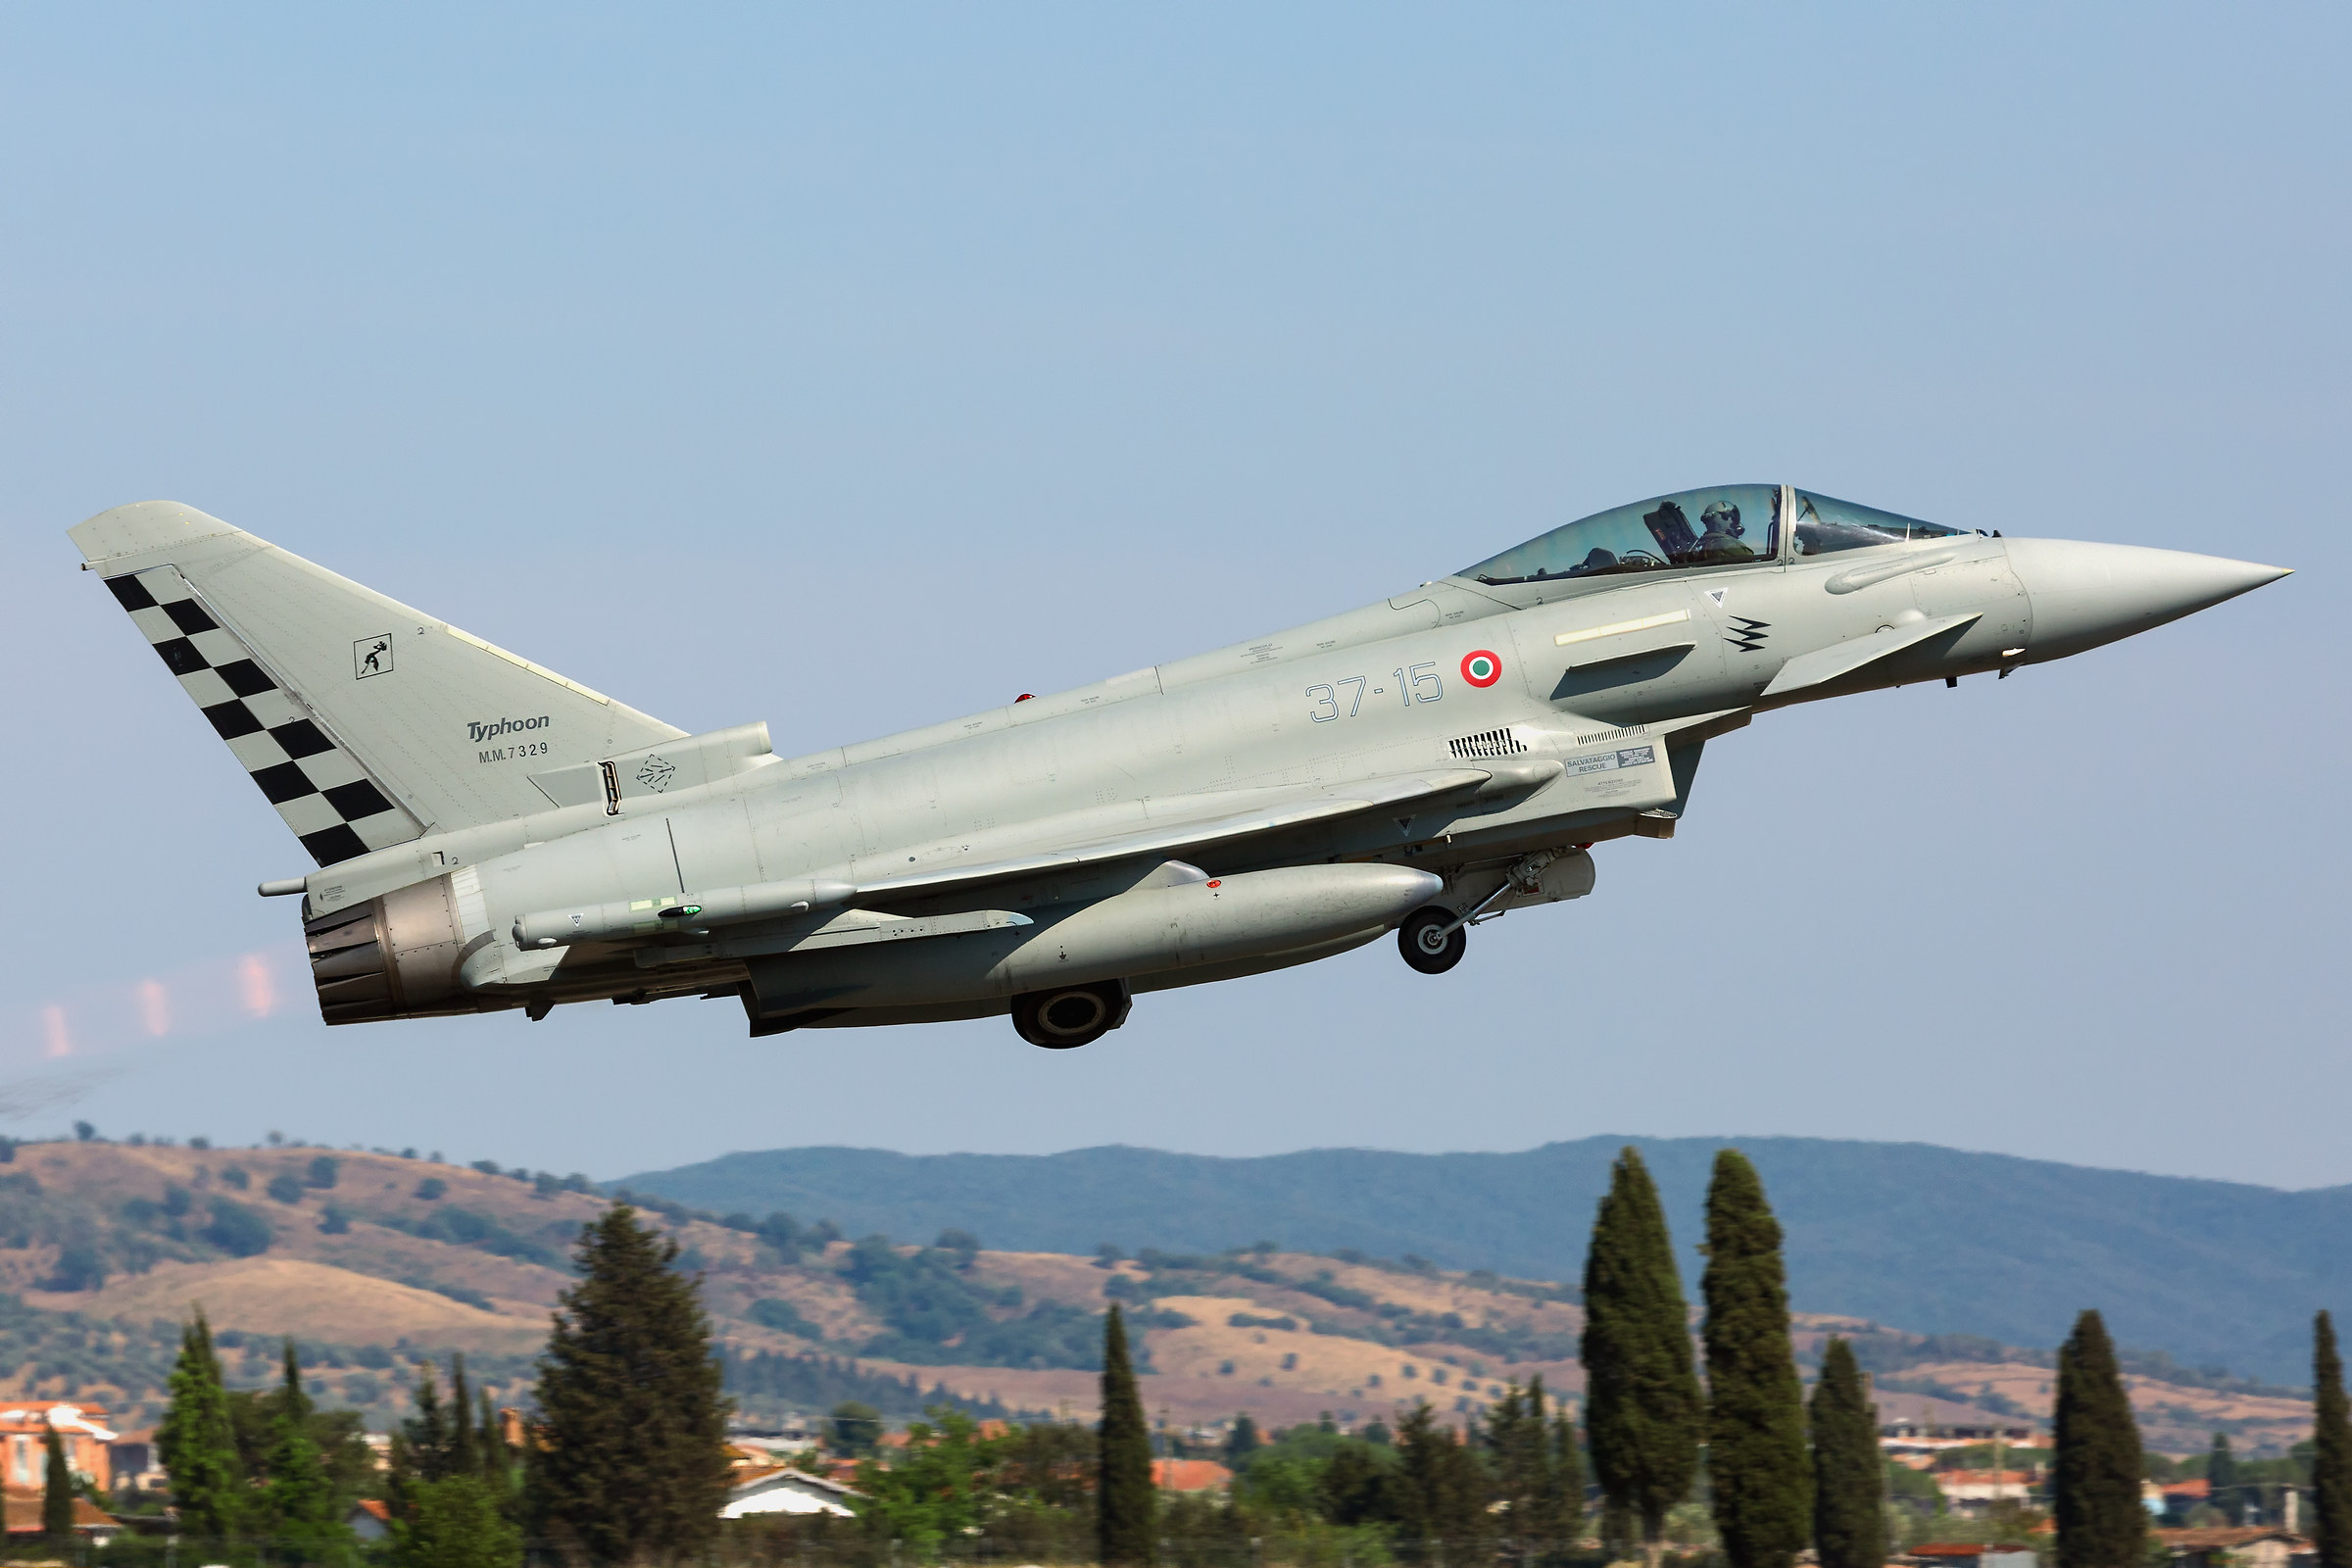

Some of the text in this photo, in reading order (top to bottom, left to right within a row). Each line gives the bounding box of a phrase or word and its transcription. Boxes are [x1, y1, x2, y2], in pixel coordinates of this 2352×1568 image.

[1305, 662, 1444, 723] 37-15
[466, 715, 550, 743] Typhoon
[1567, 754, 1616, 768] SALVATAGGIO
[1579, 762, 1607, 773] RESCUE
[451, 857, 460, 865] 2
